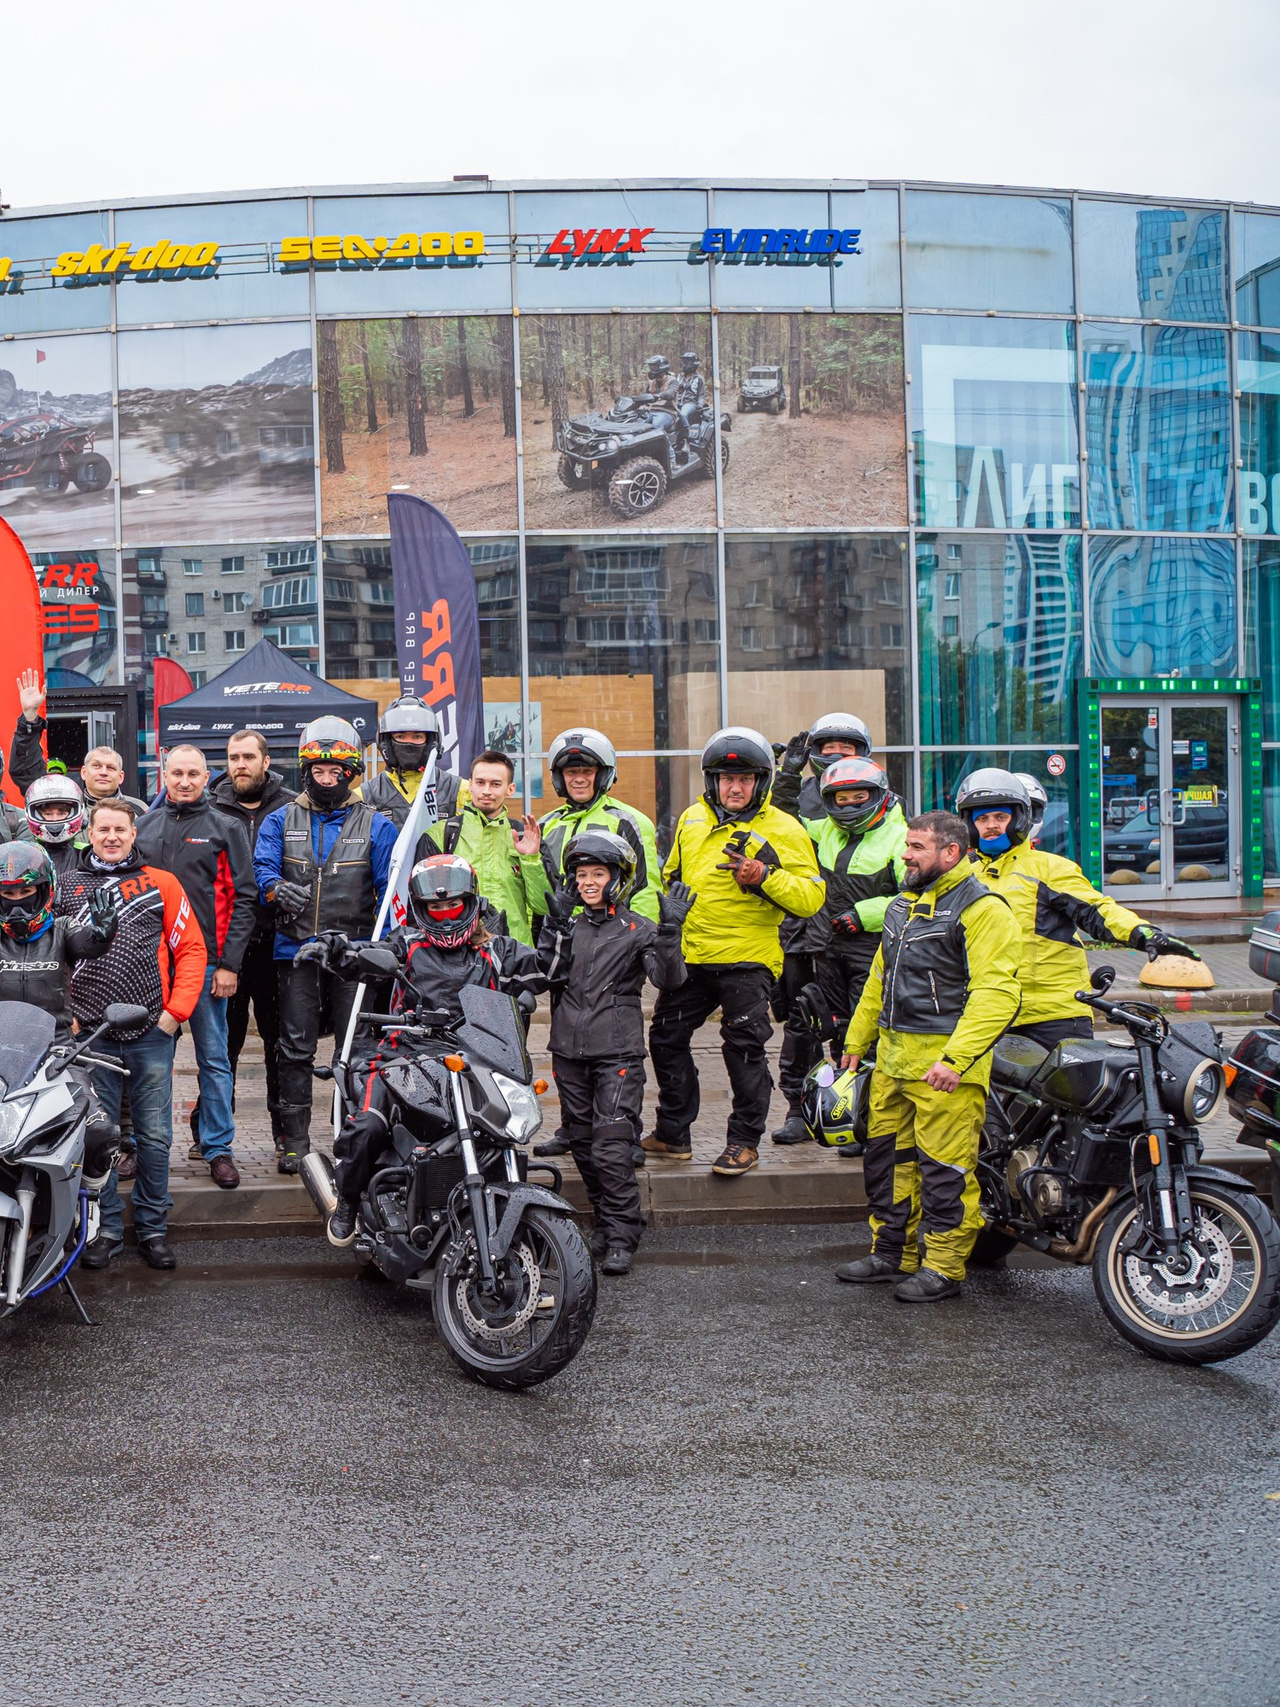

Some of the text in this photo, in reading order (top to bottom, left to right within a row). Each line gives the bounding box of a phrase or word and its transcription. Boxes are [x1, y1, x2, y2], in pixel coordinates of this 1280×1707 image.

[546, 227, 654, 257] LYNX
[701, 228, 862, 255] EVINRUDE
[51, 239, 219, 278] ski-doo
[57, 586, 100, 599] ДИЛЕР
[224, 682, 312, 694] VETERR
[832, 1097, 849, 1119] SHOEI
